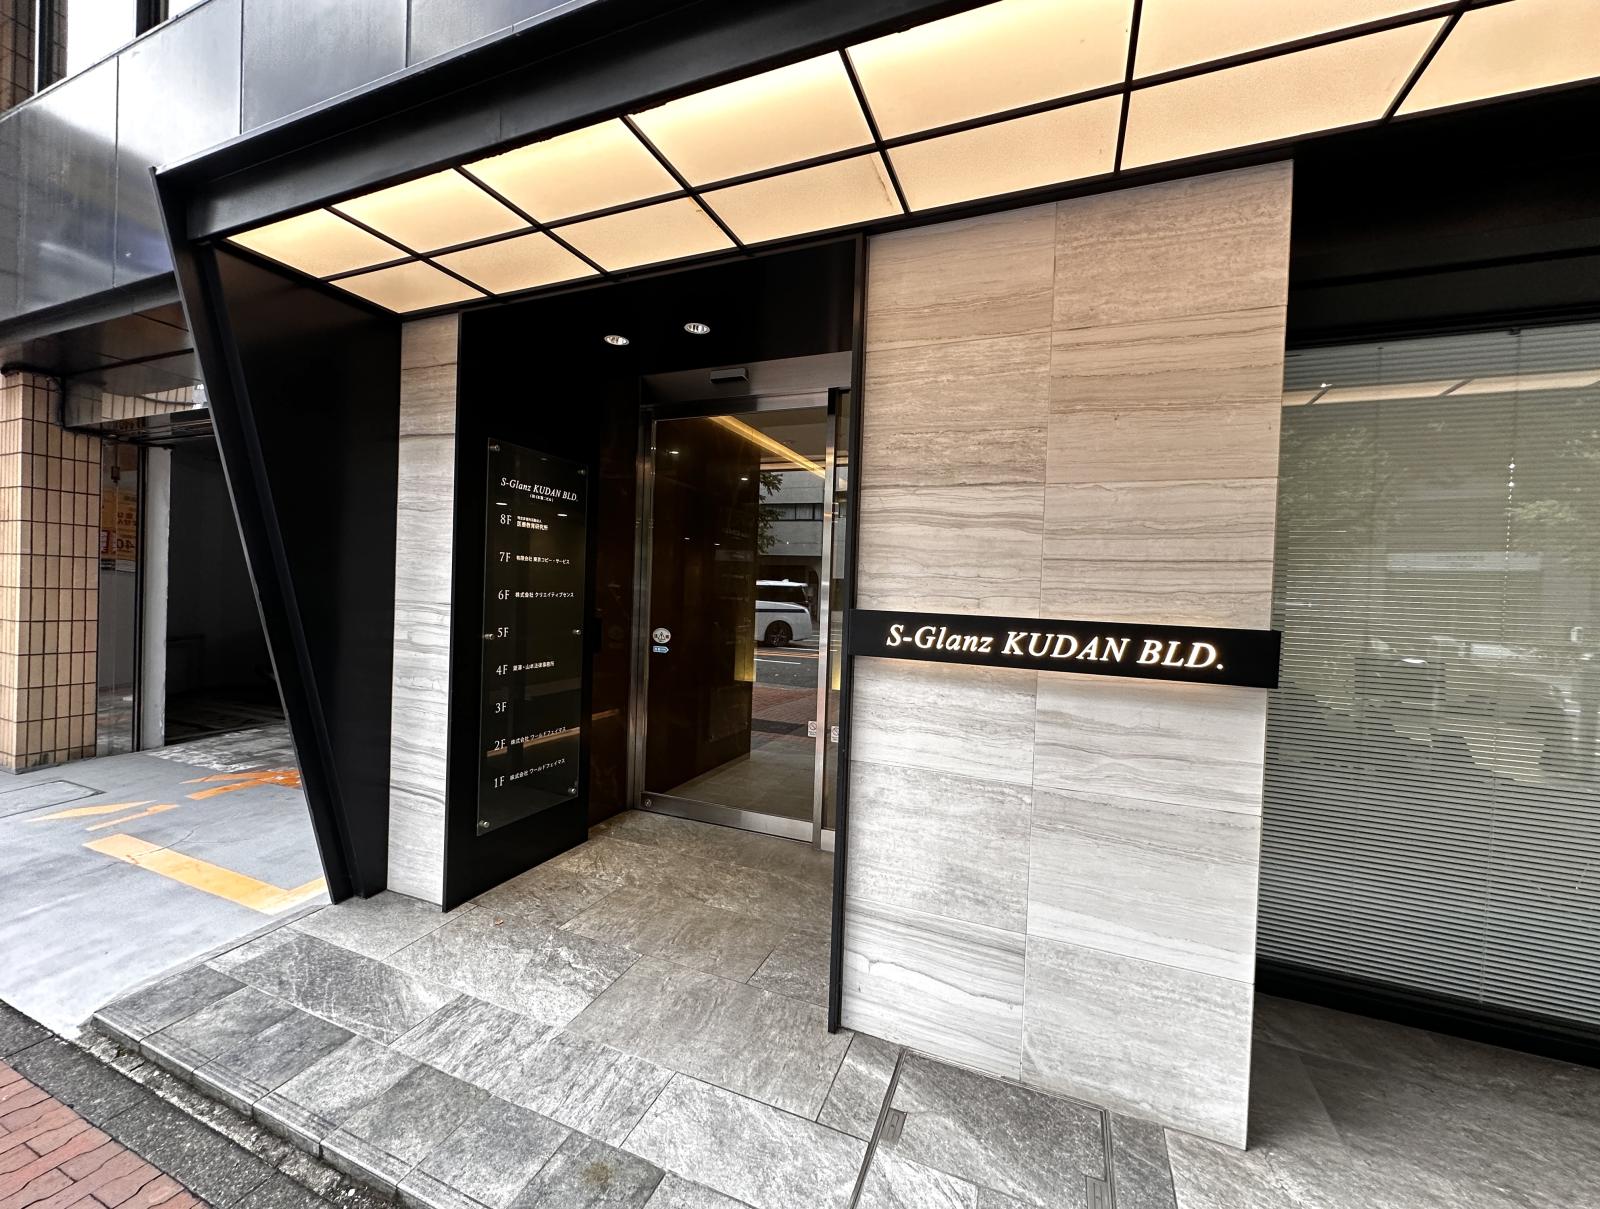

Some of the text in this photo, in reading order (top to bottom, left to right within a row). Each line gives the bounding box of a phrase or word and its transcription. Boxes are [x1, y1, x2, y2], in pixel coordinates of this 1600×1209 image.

[500, 477, 531, 492] S-Glanz
[533, 484, 561, 498] KUDAN
[500, 513, 512, 525] 8F
[499, 551, 511, 563] 7F
[498, 589, 510, 600] 6F
[497, 626, 509, 638] 5F
[886, 623, 1225, 670] S-Glanz KUDAN BLD.
[496, 664, 508, 675] 4F
[495, 701, 507, 713] 3F
[494, 738, 506, 751] 2F
[510, 735, 530, 745] 株式会社
[494, 758, 566, 788] 1F 株式会社 ワールドフェイマス
